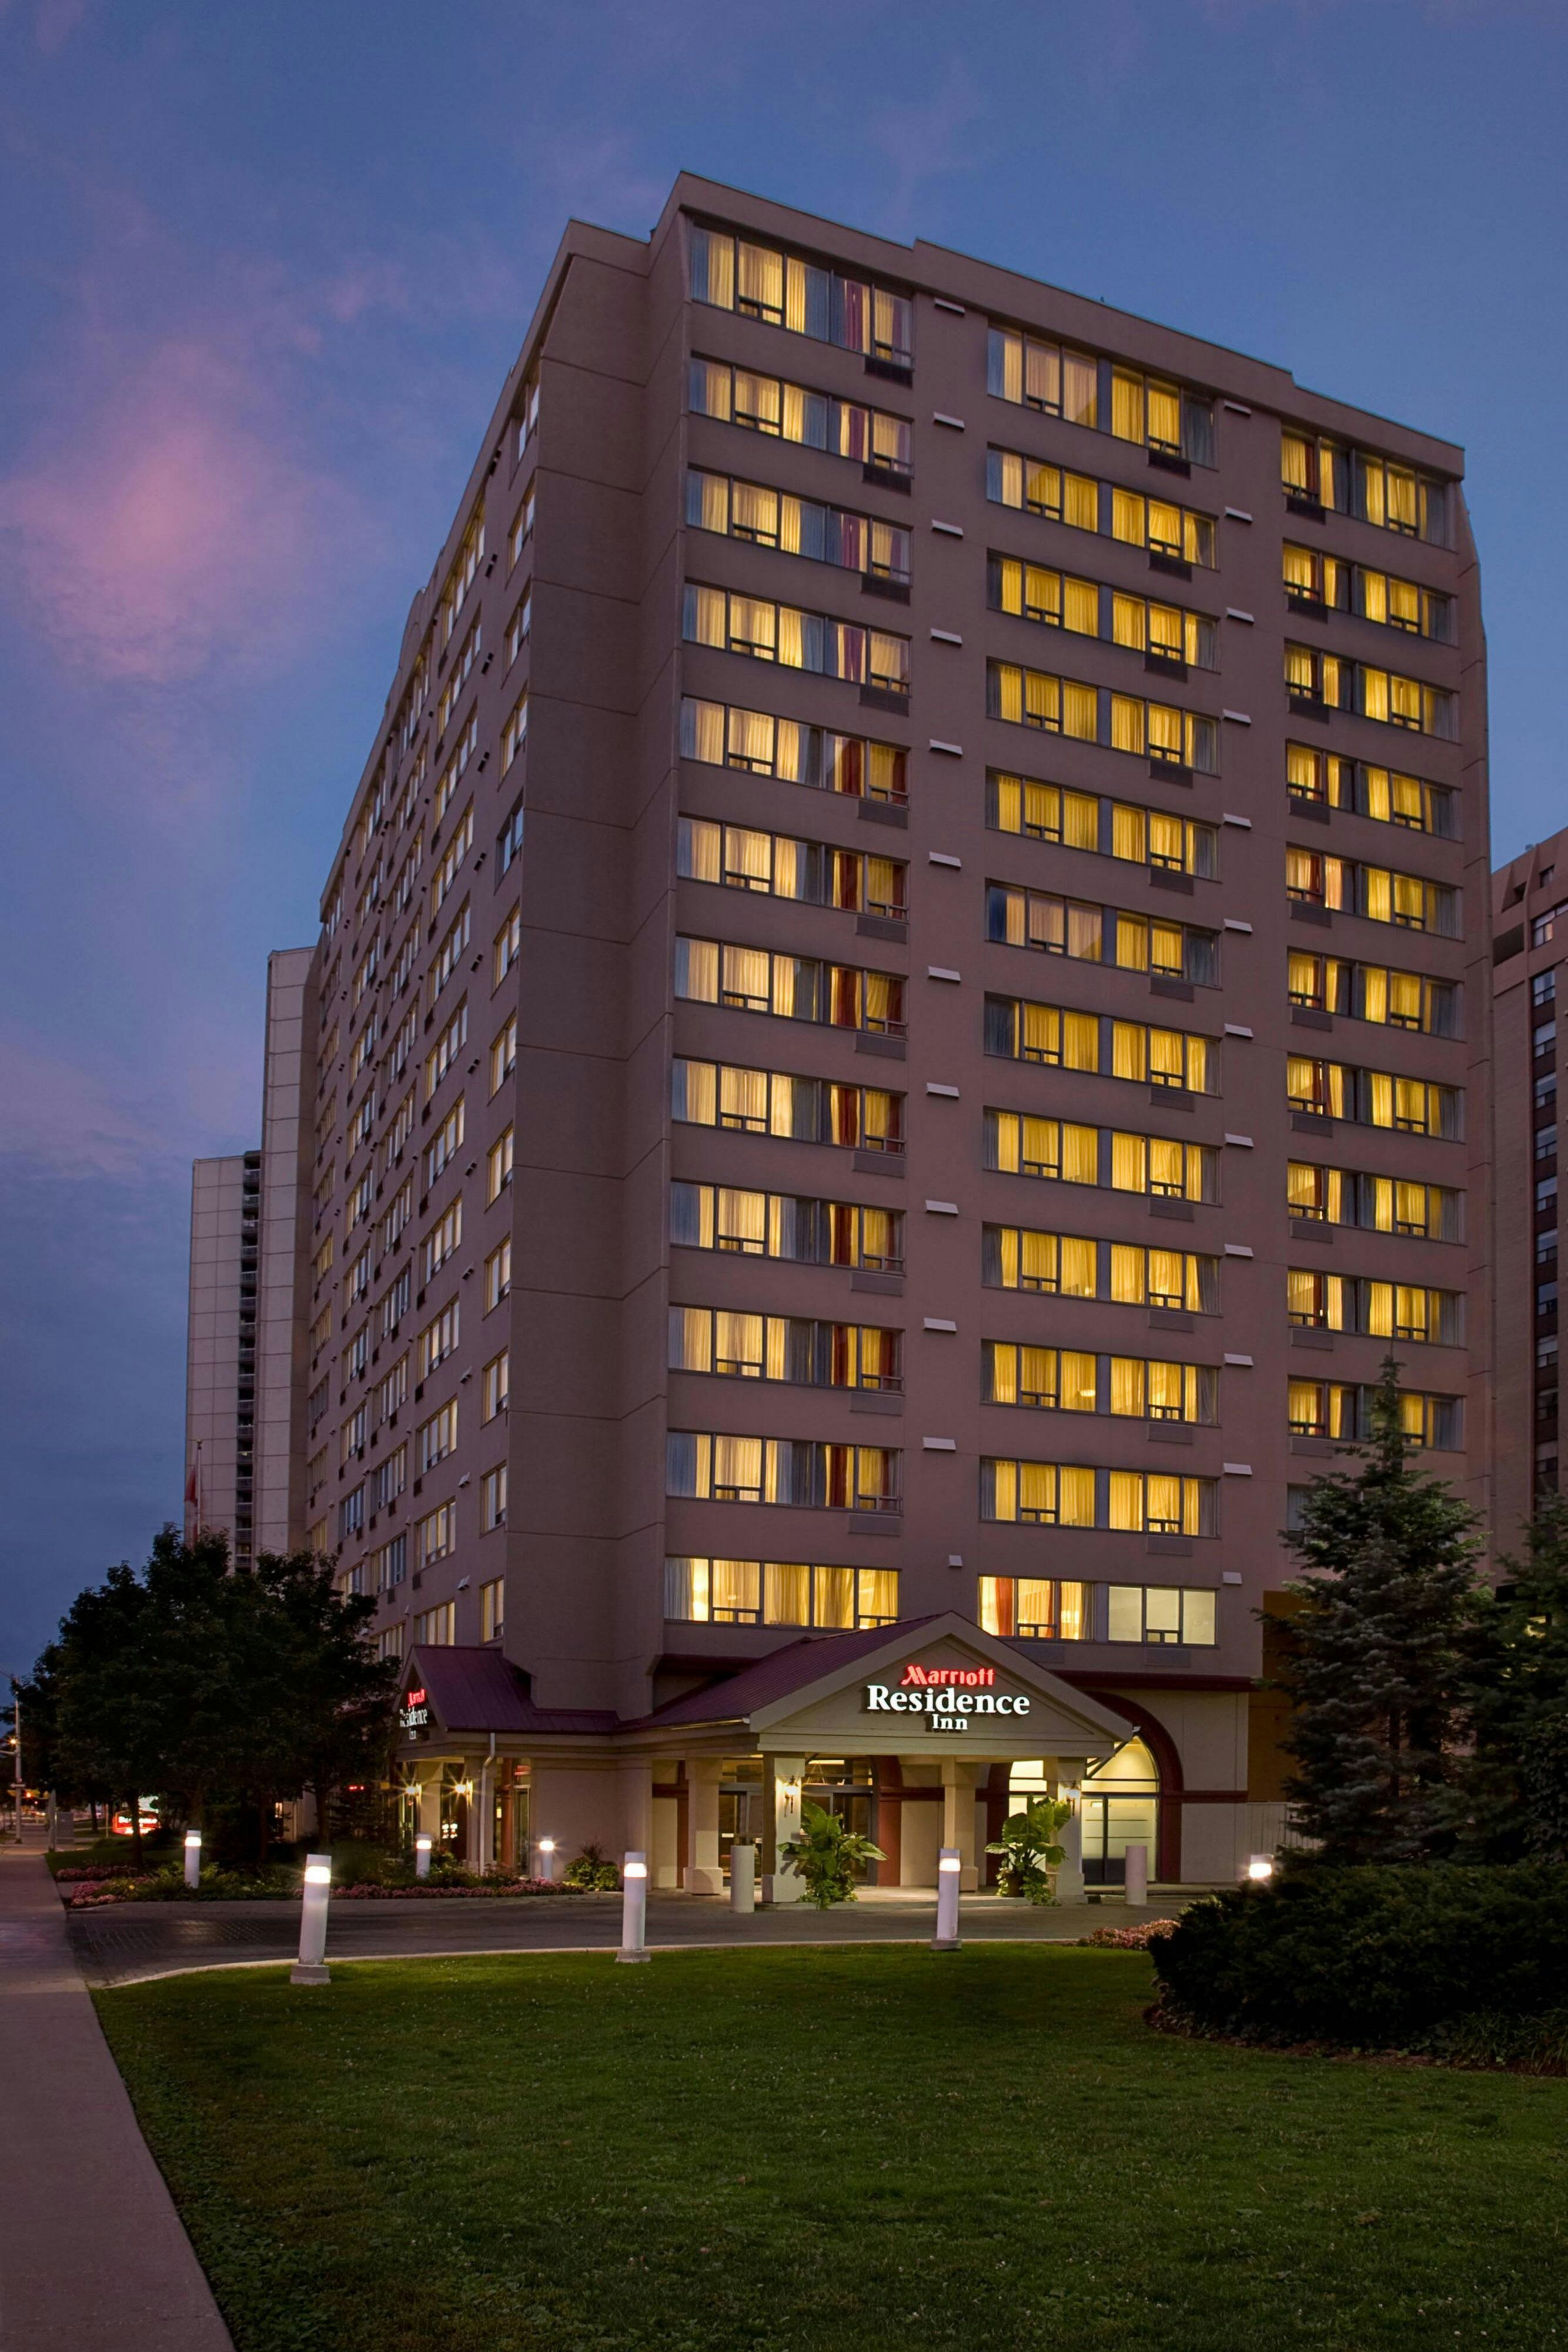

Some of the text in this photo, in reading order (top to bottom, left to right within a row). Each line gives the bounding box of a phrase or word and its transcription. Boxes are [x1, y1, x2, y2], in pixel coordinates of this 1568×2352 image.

[901, 1665, 994, 1686] Marriott
[867, 1685, 1031, 1715] Residence
[932, 1713, 968, 1730] Inn
